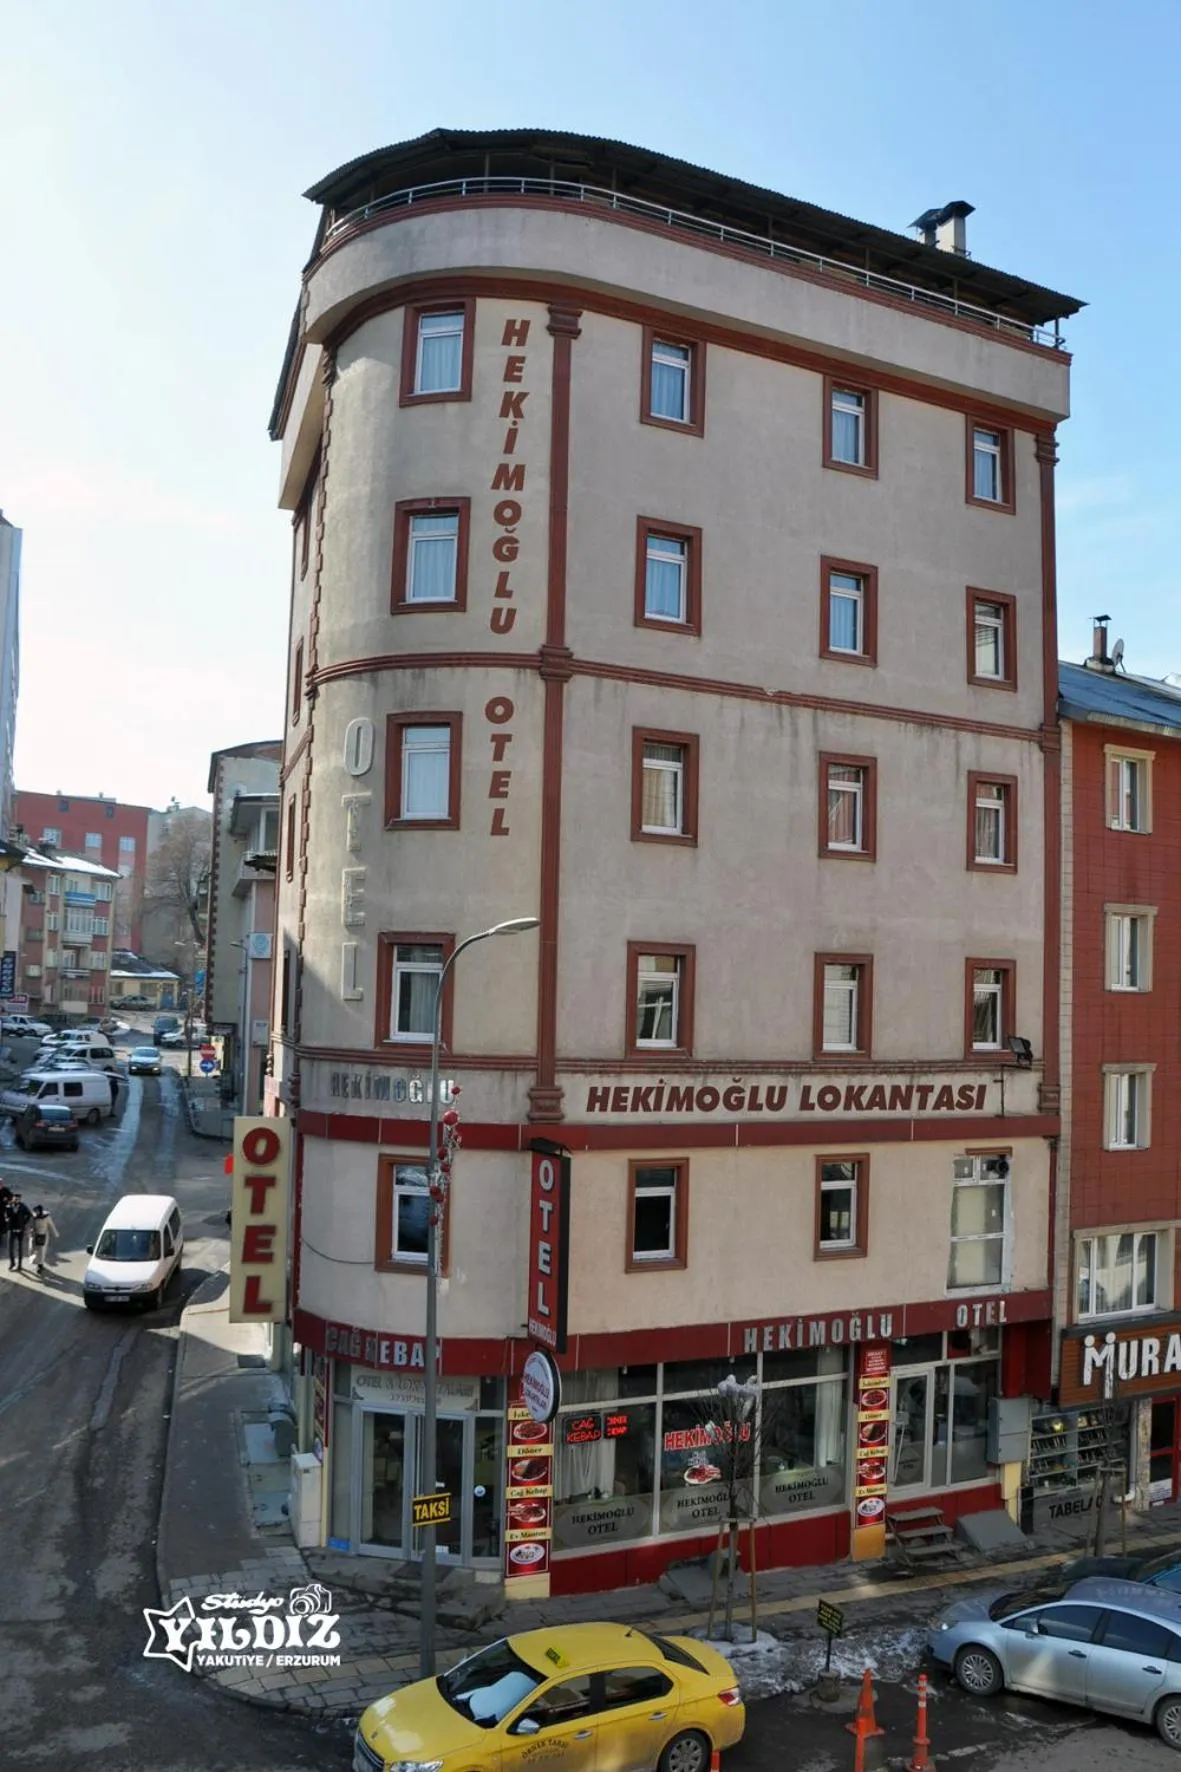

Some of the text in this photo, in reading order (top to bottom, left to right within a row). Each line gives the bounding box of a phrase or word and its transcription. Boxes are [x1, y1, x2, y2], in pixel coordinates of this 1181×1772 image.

[490, 319, 530, 635] HEKİMOĞLU
[485, 697, 514, 836] OTEL
[341, 716, 374, 1000] OTEL
[586, 1077, 988, 1113] HEKİMOĞLU LOKANTASI
[241, 1127, 281, 1314] OTEL
[537, 1159, 554, 1317] OTEL
[365, 1336, 441, 1368] KEBA
[744, 1300, 1008, 1354] HEKİMOĞLU OTEL
[413, 1496, 450, 1520] TAKSİ
[588, 1521, 619, 1536] OTEL
